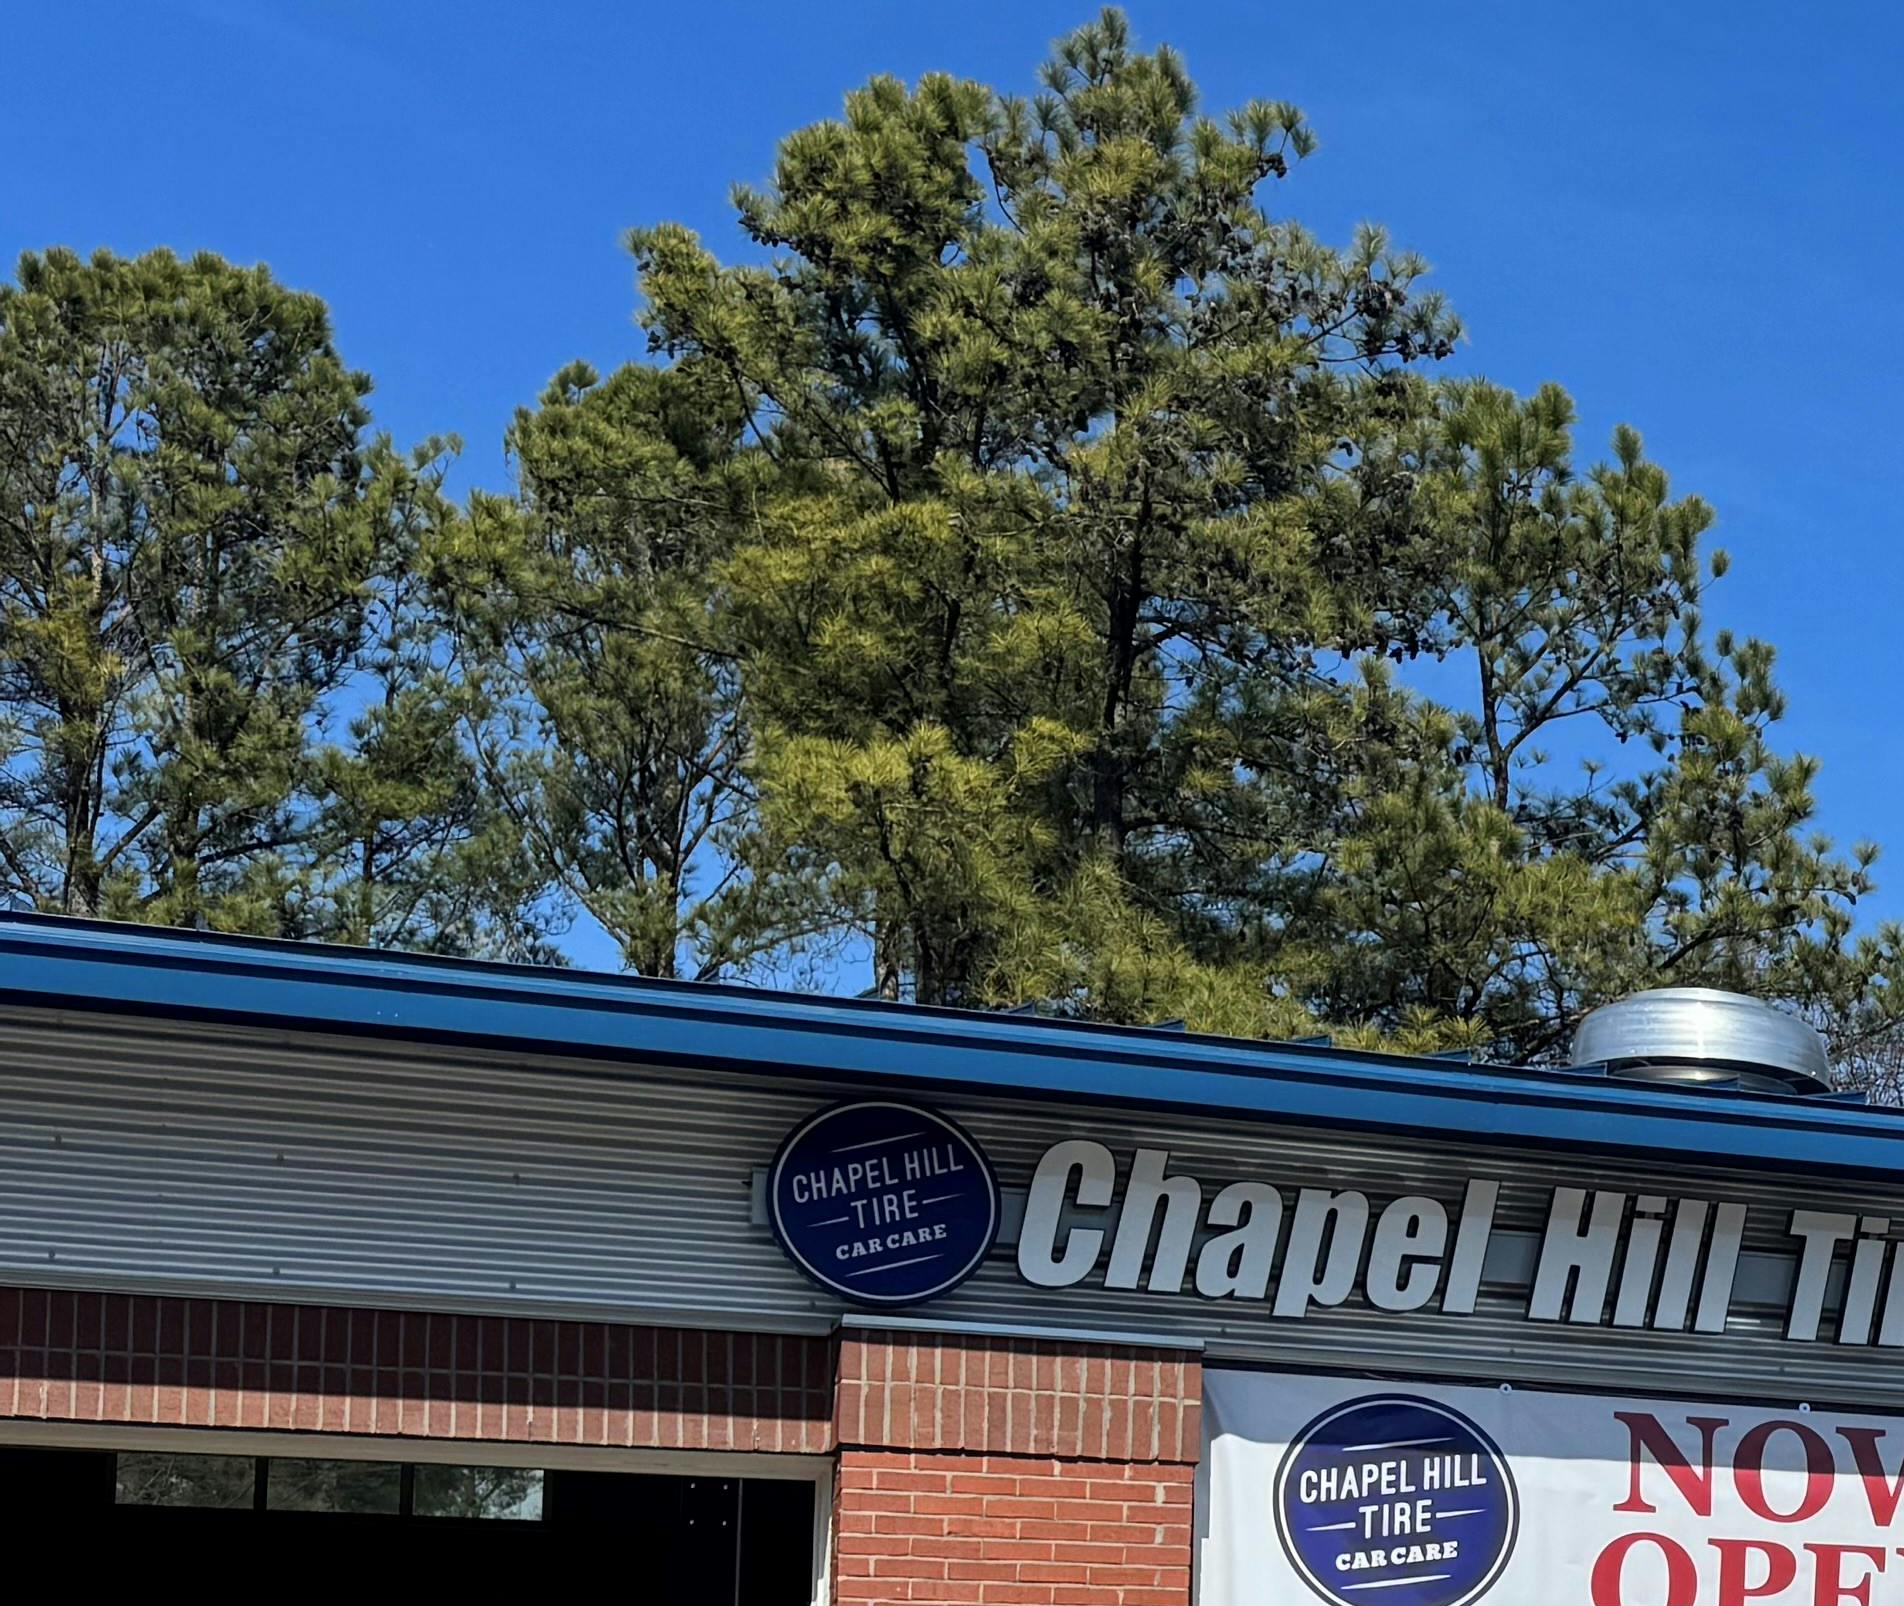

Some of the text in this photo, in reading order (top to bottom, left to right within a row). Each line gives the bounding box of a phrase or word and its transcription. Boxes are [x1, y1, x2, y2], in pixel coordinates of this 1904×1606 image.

[793, 1143, 964, 1203] CHAPEL HILL
[851, 1189, 918, 1229] TIRE
[835, 1224, 947, 1260] CAR CARE
[1016, 1139, 1504, 1319] Chapel
[1527, 1185, 1750, 1336] Hill
[1300, 1453, 1487, 1504] CHAPEL HILL
[1358, 1499, 1432, 1539] TIRE
[1335, 1541, 1458, 1571] CAR CARE
